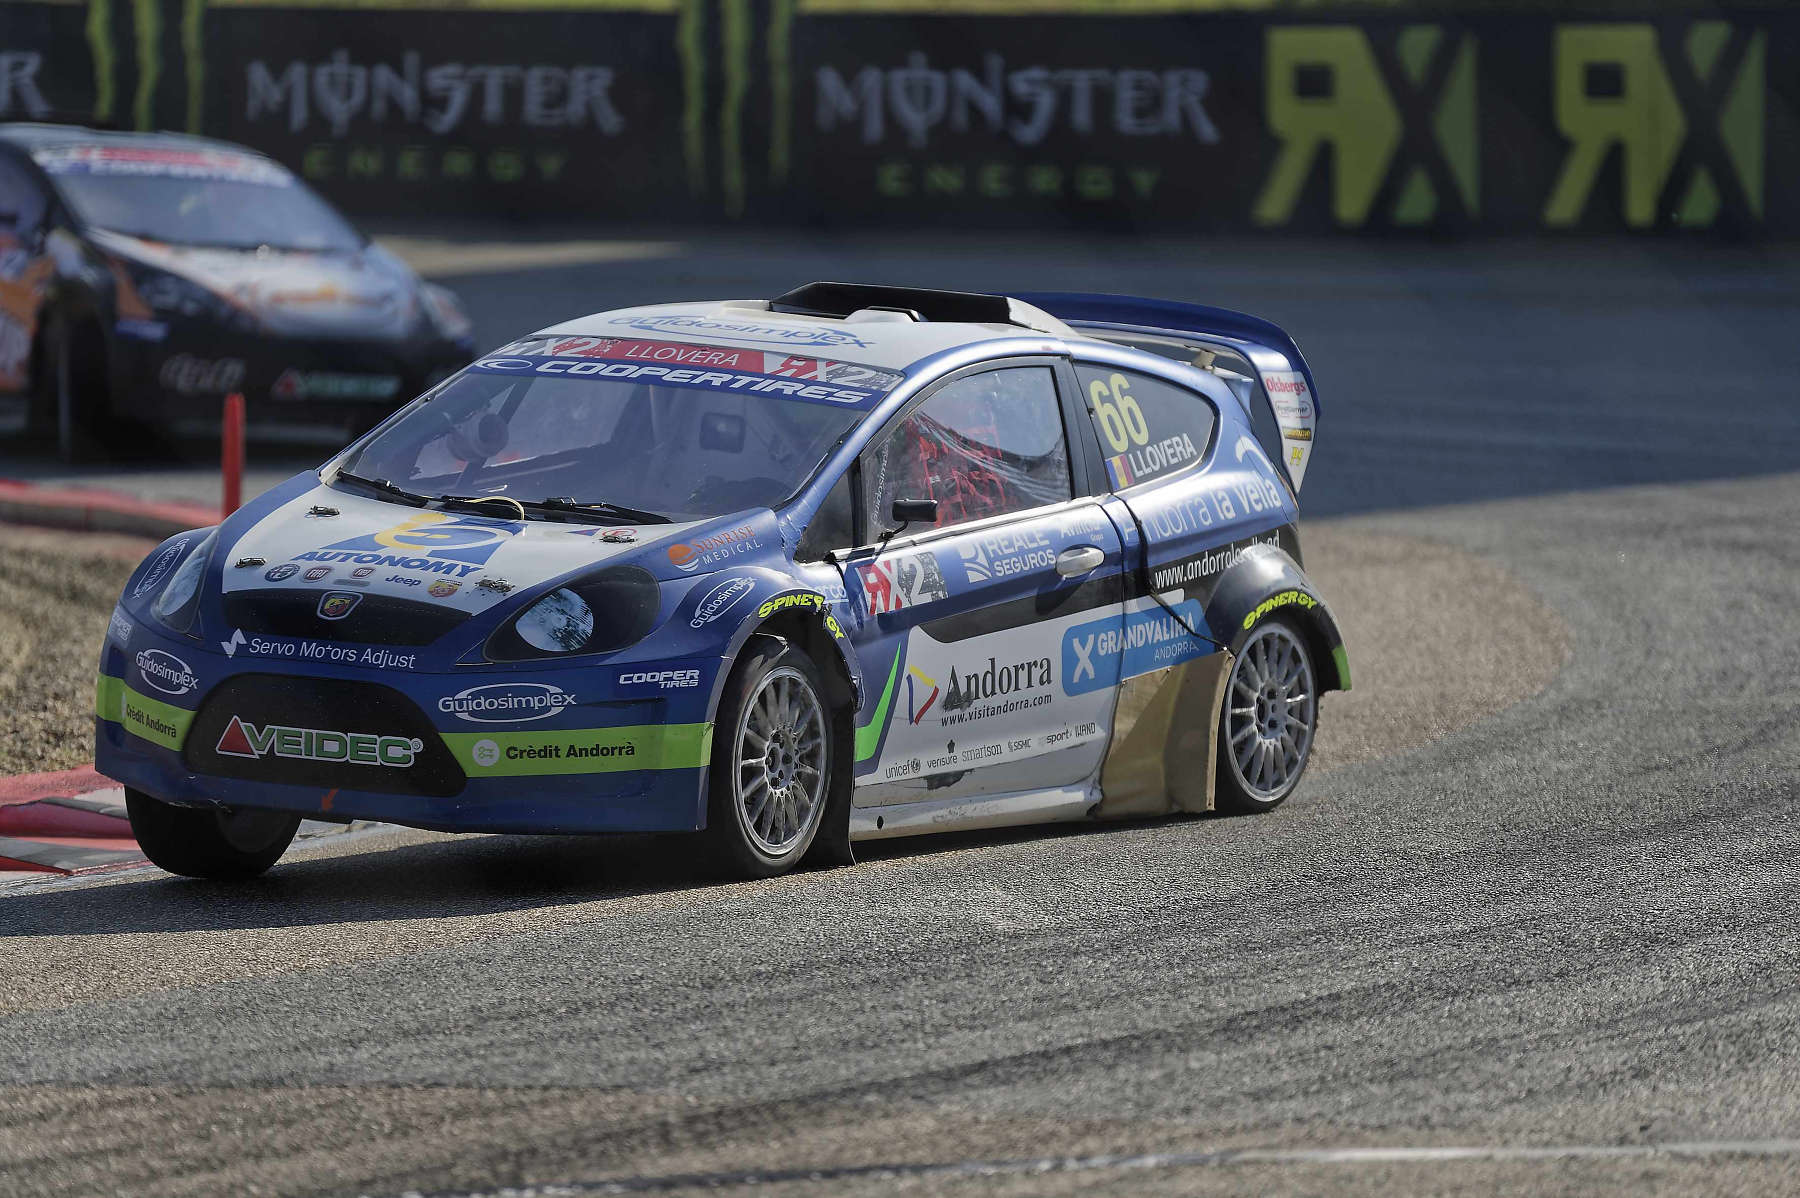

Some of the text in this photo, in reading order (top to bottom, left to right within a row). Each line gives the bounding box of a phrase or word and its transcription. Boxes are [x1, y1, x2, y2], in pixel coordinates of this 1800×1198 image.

[245, 50, 624, 137] MONSTER
[814, 50, 1221, 150] MONSTER
[304, 146, 568, 182] ENERGY
[875, 163, 1163, 198] ENERGY
[625, 344, 741, 367] LLOVERA
[1089, 373, 1149, 453] 66
[1128, 432, 1198, 479] LLOVERA
[1209, 487, 1236, 520] la
[690, 525, 756, 553] SUNRISE
[983, 530, 1050, 558] REALE
[290, 551, 485, 578] AUTONOMY
[995, 549, 1056, 578] SEGUROS
[385, 575, 422, 587] Jeep
[690, 577, 757, 629] Guidosimplex
[1242, 590, 1317, 630] SPINERGY
[1097, 611, 1196, 656] GRANDVALIRA
[249, 638, 295, 656] Servo
[360, 648, 416, 669] Adjust
[1153, 640, 1200, 662] ANDORRA
[135, 649, 200, 690] Guidosimplex
[619, 670, 700, 685] COOPER
[659, 679, 699, 688] TIRES
[943, 656, 1053, 708] Andorra
[438, 690, 577, 713] Guidosimplex
[941, 692, 1053, 727] www.visitandorra.com
[505, 742, 636, 760] Crèdit Andorrà
[885, 759, 912, 779] unicef
